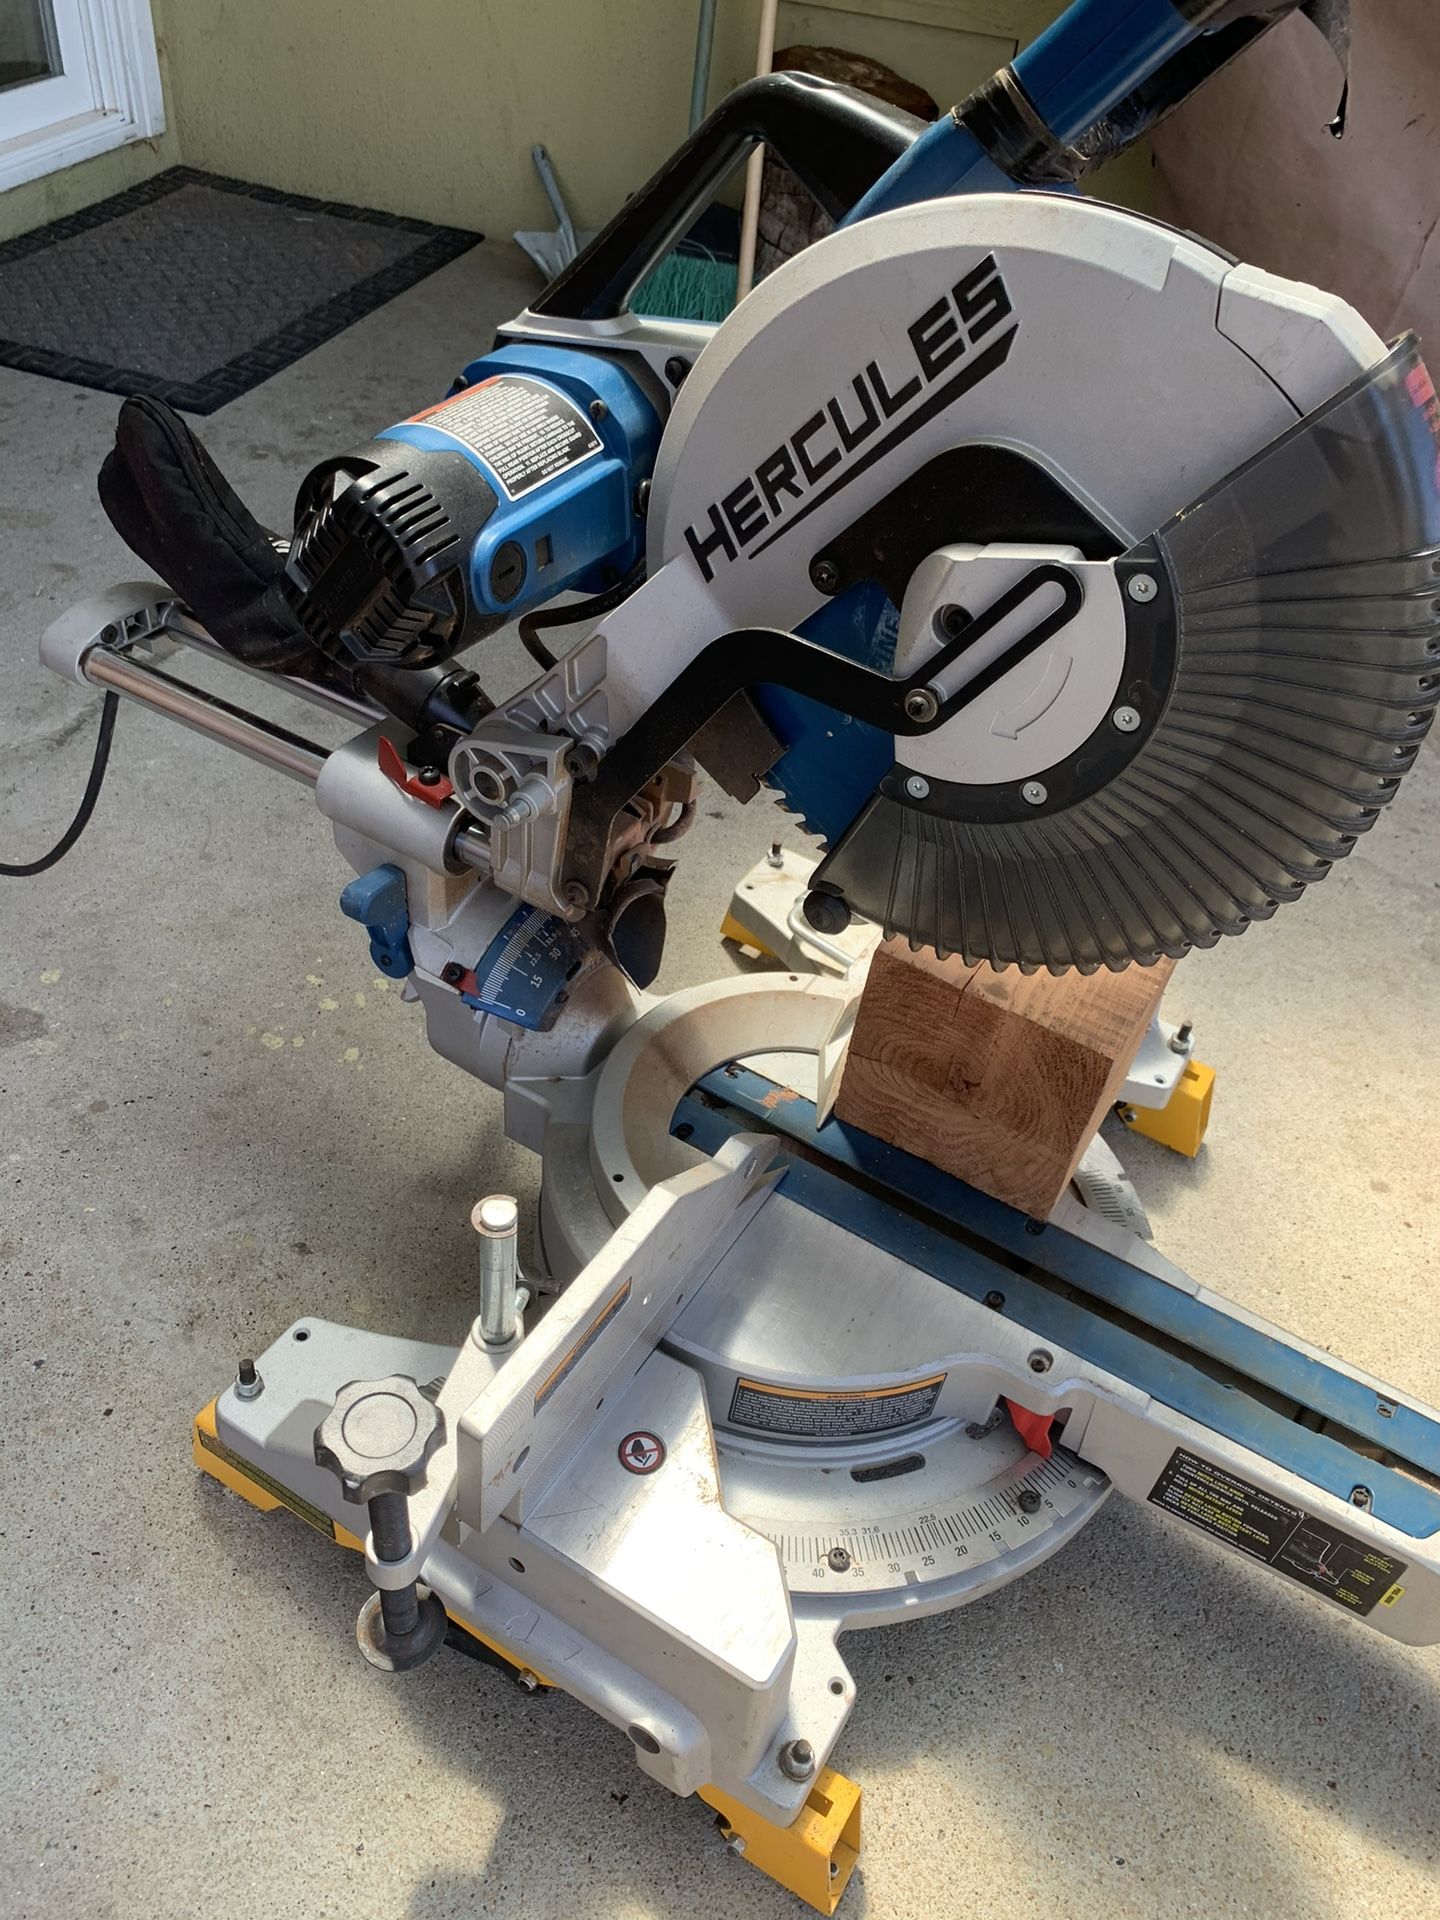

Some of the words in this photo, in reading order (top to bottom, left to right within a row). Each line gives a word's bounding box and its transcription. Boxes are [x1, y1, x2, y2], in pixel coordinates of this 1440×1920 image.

[684, 251, 1015, 583] HERCULES
[549, 947, 561, 961] 30
[530, 975, 543, 989] 15
[515, 1008, 527, 1017] 0
[1067, 1479, 1077, 1489] 0
[1178, 1452, 1198, 1464] HOW
[1213, 1470, 1256, 1494] OVERRIDE
[1257, 1493, 1297, 1516] DETENTS
[1044, 1499, 1053, 1510] 5
[918, 1512, 937, 1525] 22.5
[1016, 1515, 1030, 1528] 10
[840, 1528, 858, 1537] 35.3
[862, 1525, 880, 1535] 31.6
[988, 1530, 1002, 1543] 15
[954, 1543, 969, 1557] 20
[921, 1554, 936, 1568] 25
[812, 1567, 825, 1578] 40
[851, 1567, 865, 1578] 35
[887, 1562, 901, 1574] 30
